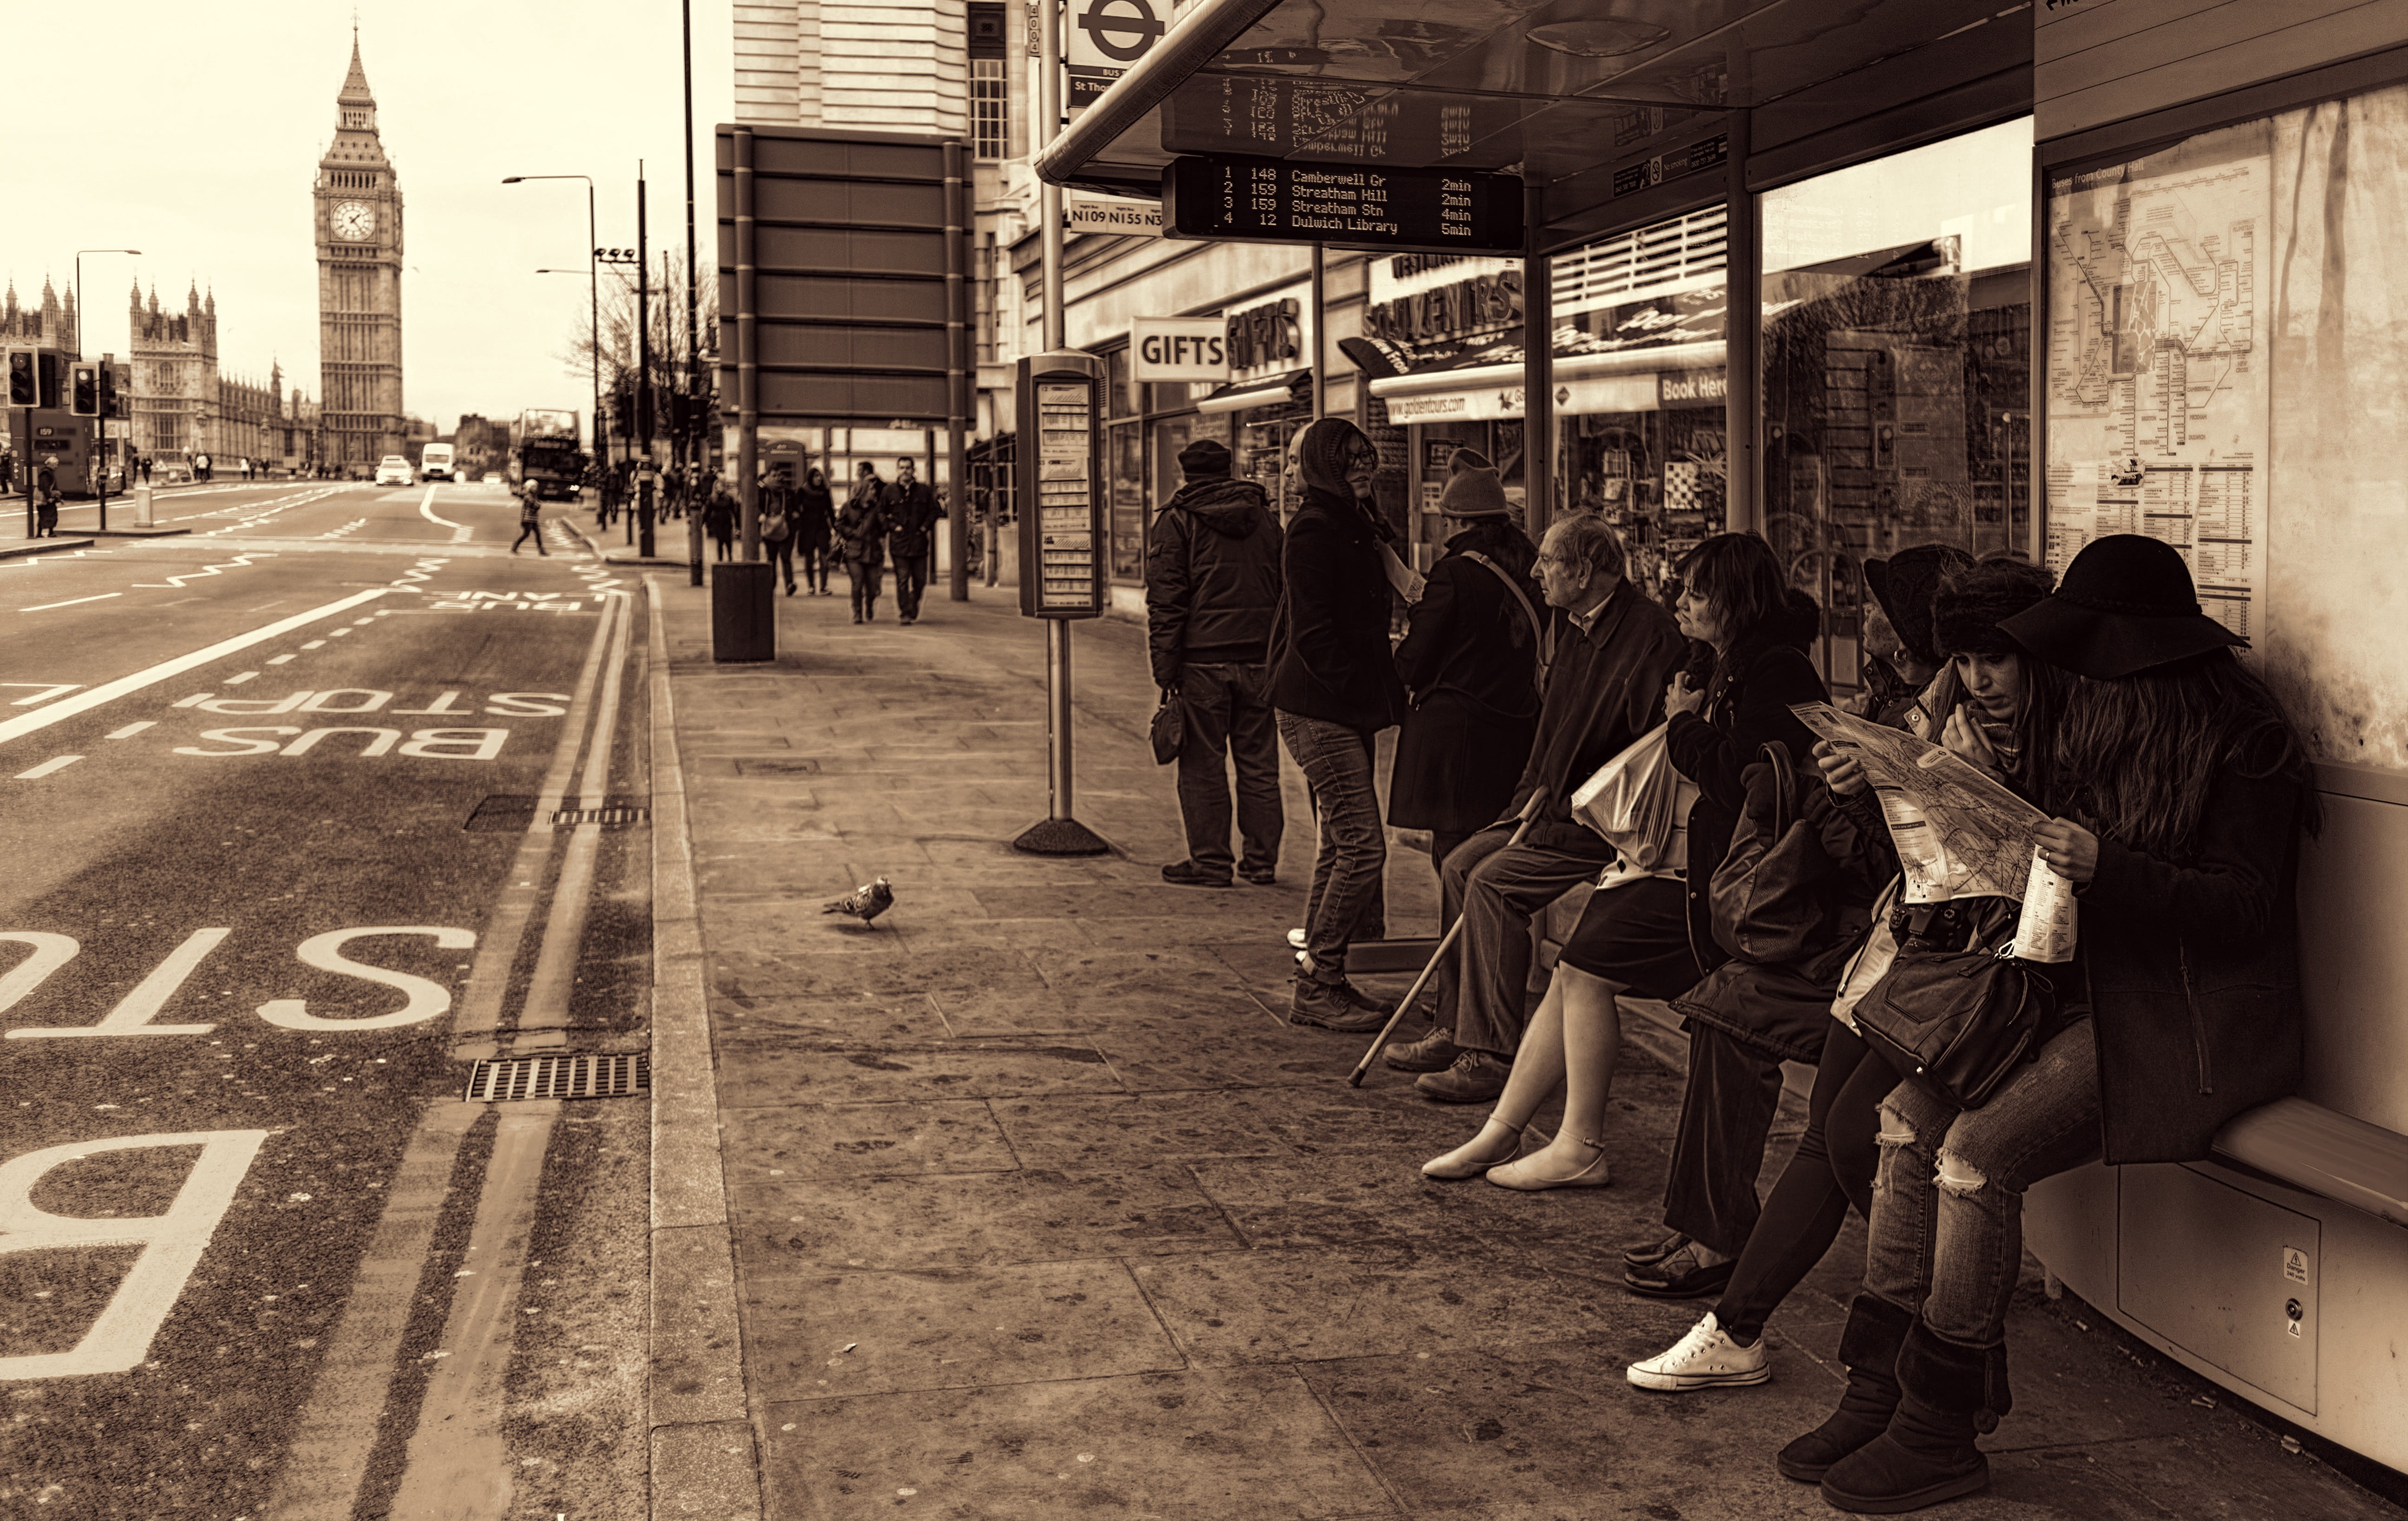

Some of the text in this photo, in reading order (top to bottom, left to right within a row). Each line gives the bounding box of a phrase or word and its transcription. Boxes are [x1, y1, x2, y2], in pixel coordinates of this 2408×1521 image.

[1075, 81, 1086, 91] St
[1664, 157, 1688, 171] No smoking
[2052, 159, 2144, 189] Buses from County Hall
[1225, 166, 1471, 191] 1 148 Camberwell Gr 2min
[1224, 182, 1471, 206] 2 159 Streatham Hill 2min
[1073, 210, 1106, 222] N109
[1110, 212, 1141, 224] N155
[1224, 197, 1471, 221] 3 159 Streatham Stn 4min
[1224, 212, 1471, 236] 4 12 Dulwich Library 5min
[1364, 270, 1518, 341] SOUVENIRS
[1142, 336, 1223, 365] GIFTS
[1662, 376, 1697, 400] Book
[195, 688, 572, 716] STOP
[172, 727, 510, 760] BUS
[2287, 1263, 2305, 1274] Danger
